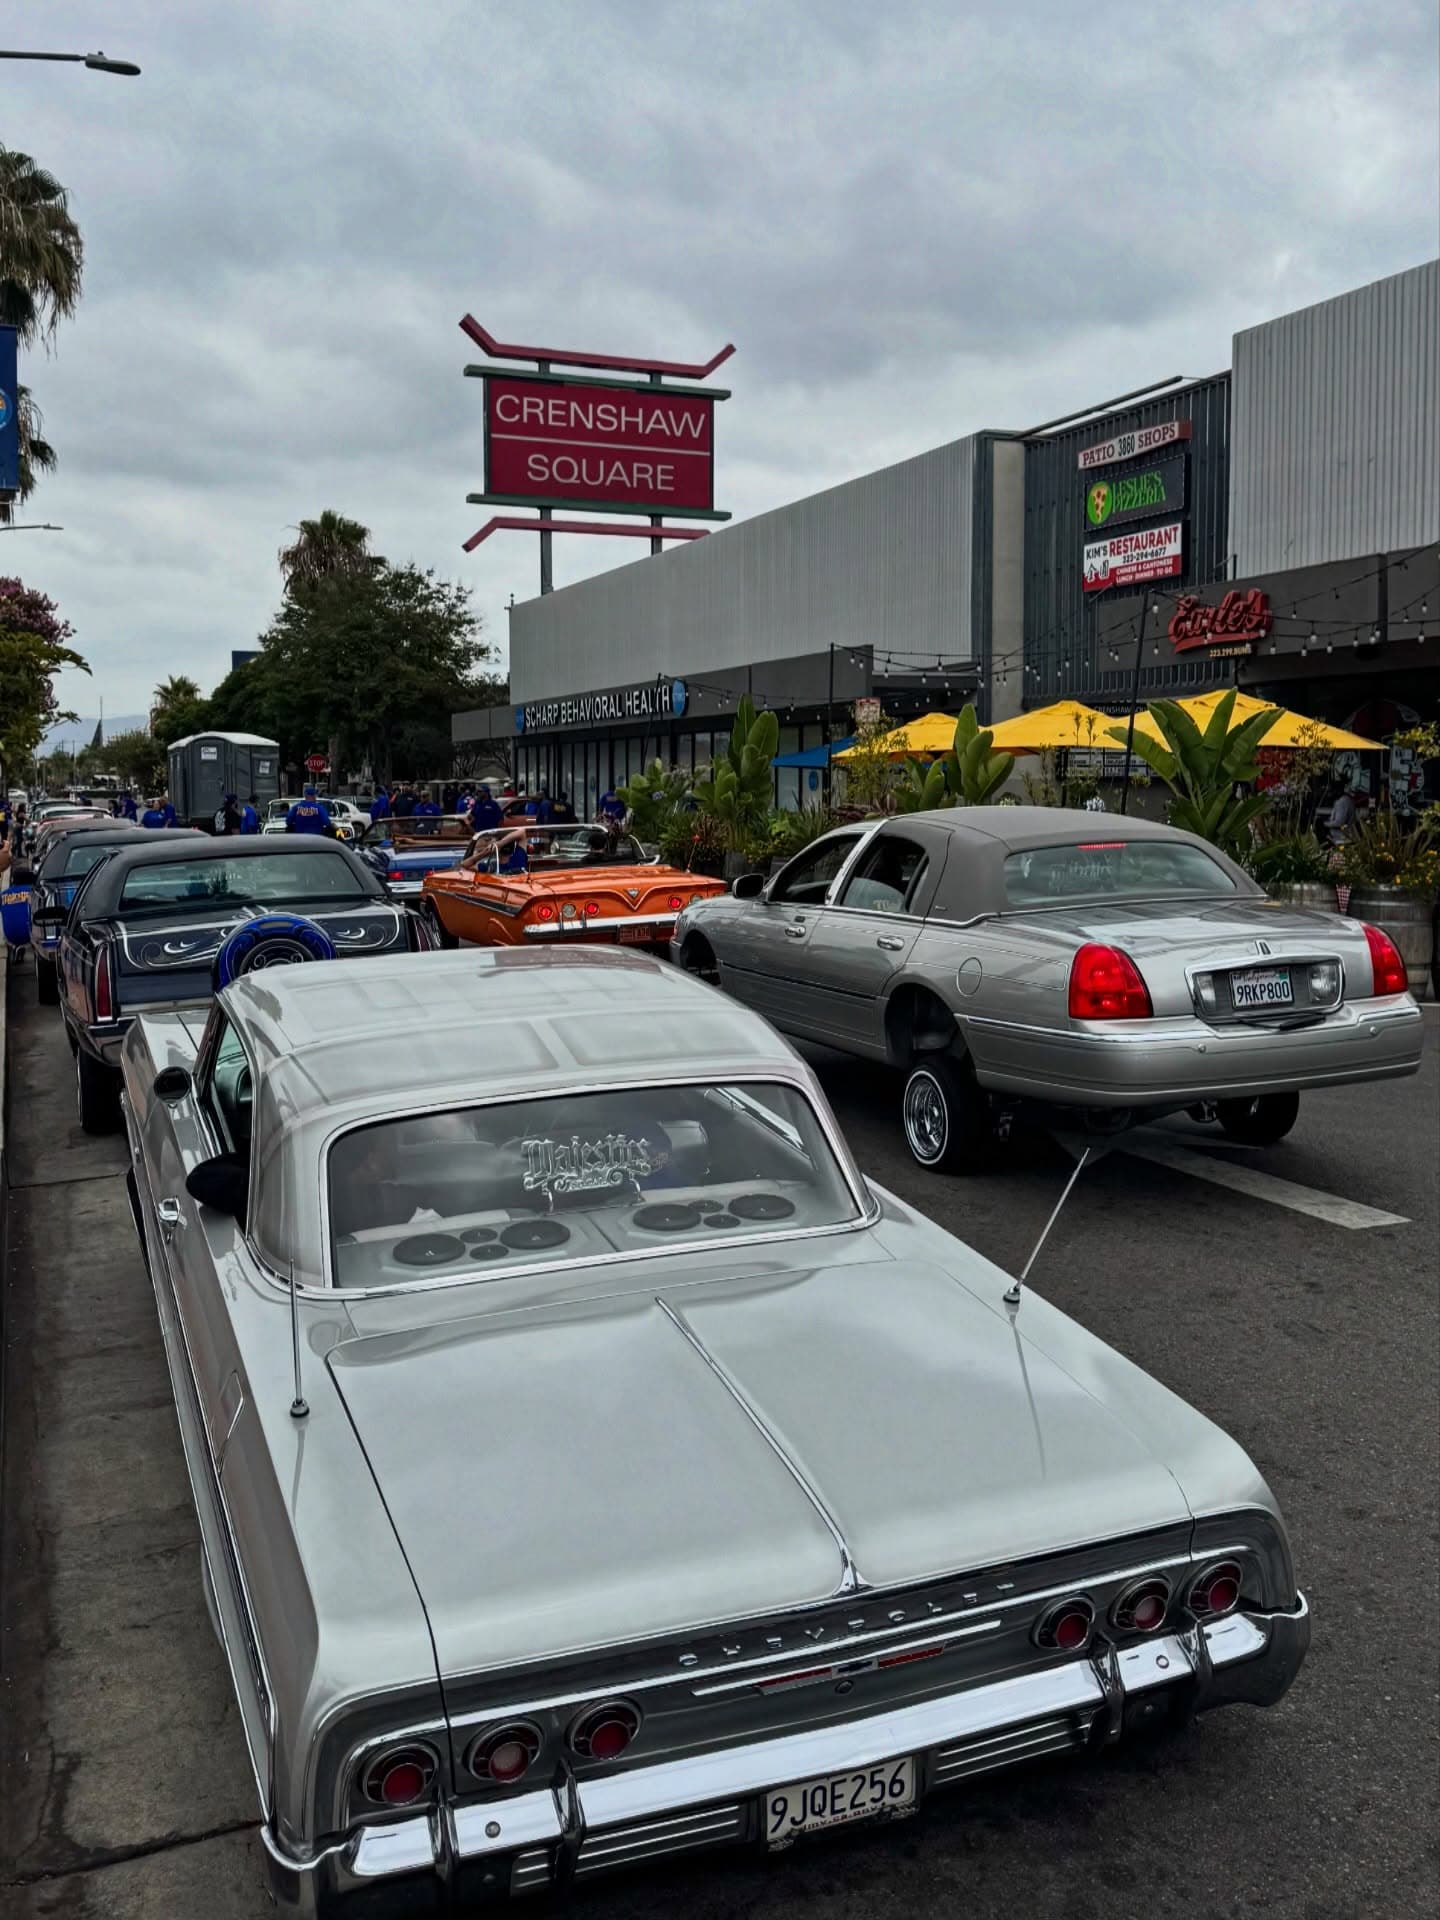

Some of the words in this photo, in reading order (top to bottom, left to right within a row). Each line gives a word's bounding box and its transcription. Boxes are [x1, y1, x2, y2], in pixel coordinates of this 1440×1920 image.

[496, 394, 705, 439] CRENSHAW
[1082, 443, 1115, 466] PATIO
[1118, 434, 1136, 457] 3860
[1138, 423, 1176, 449] SHOPS
[527, 453, 675, 491] SQUARE
[1086, 545, 1108, 560] KIM'S
[1109, 526, 1179, 557] RESTAURANT
[1168, 588, 1271, 645] Earle's
[525, 703, 558, 728] SCHARP
[561, 696, 622, 724] BEHAVIORAL
[625, 684, 670, 714] HEALTH
[1236, 981, 1290, 1003] 9RKP800
[521, 1134, 651, 1190] Majestics
[679, 1583, 1015, 1666] CHEVROLET
[770, 1761, 906, 1833] 9JQE256
